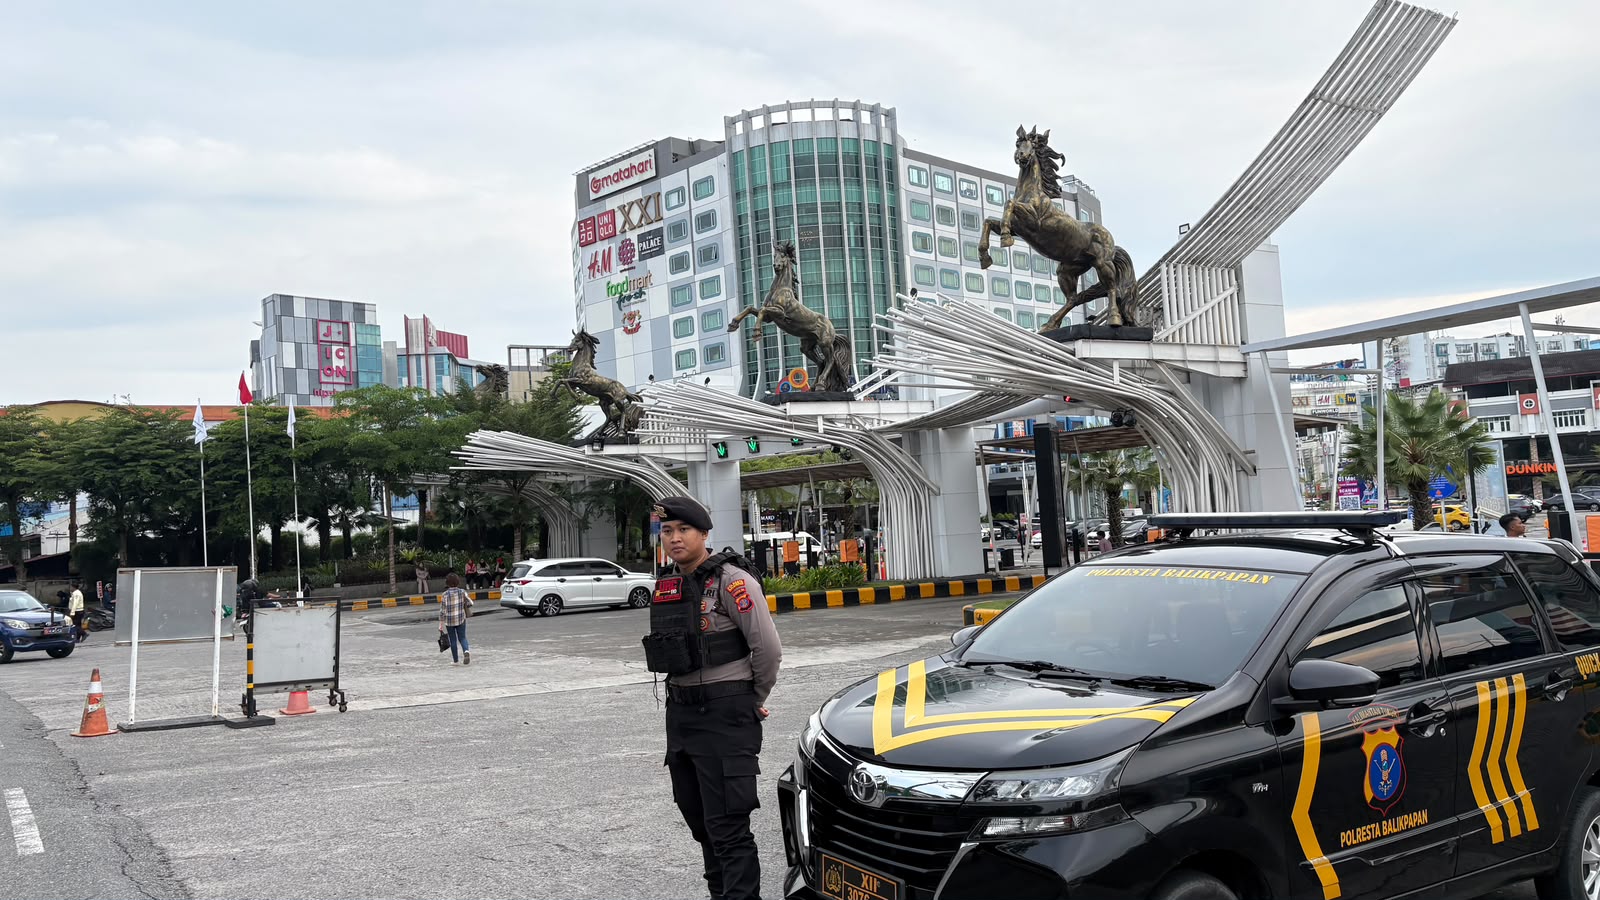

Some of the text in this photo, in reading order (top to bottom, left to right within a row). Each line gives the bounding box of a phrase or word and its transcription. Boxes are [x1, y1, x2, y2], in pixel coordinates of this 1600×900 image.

[601, 154, 653, 188] matahari
[598, 213, 612, 225] UNI
[617, 192, 663, 233] XXI
[580, 220, 592, 232] ユニ
[599, 224, 613, 237] QLO
[580, 231, 593, 243] クロ
[638, 237, 661, 251] PALACE
[587, 245, 612, 279] H&M
[606, 270, 653, 297] foodmart
[1506, 463, 1557, 475] DUNKIN
[1086, 568, 1275, 585] POLRESTA BALIKPAPAN
[1340, 809, 1428, 848] POLRESTA BALIKPAPAN
[861, 873, 878, 893] XII
